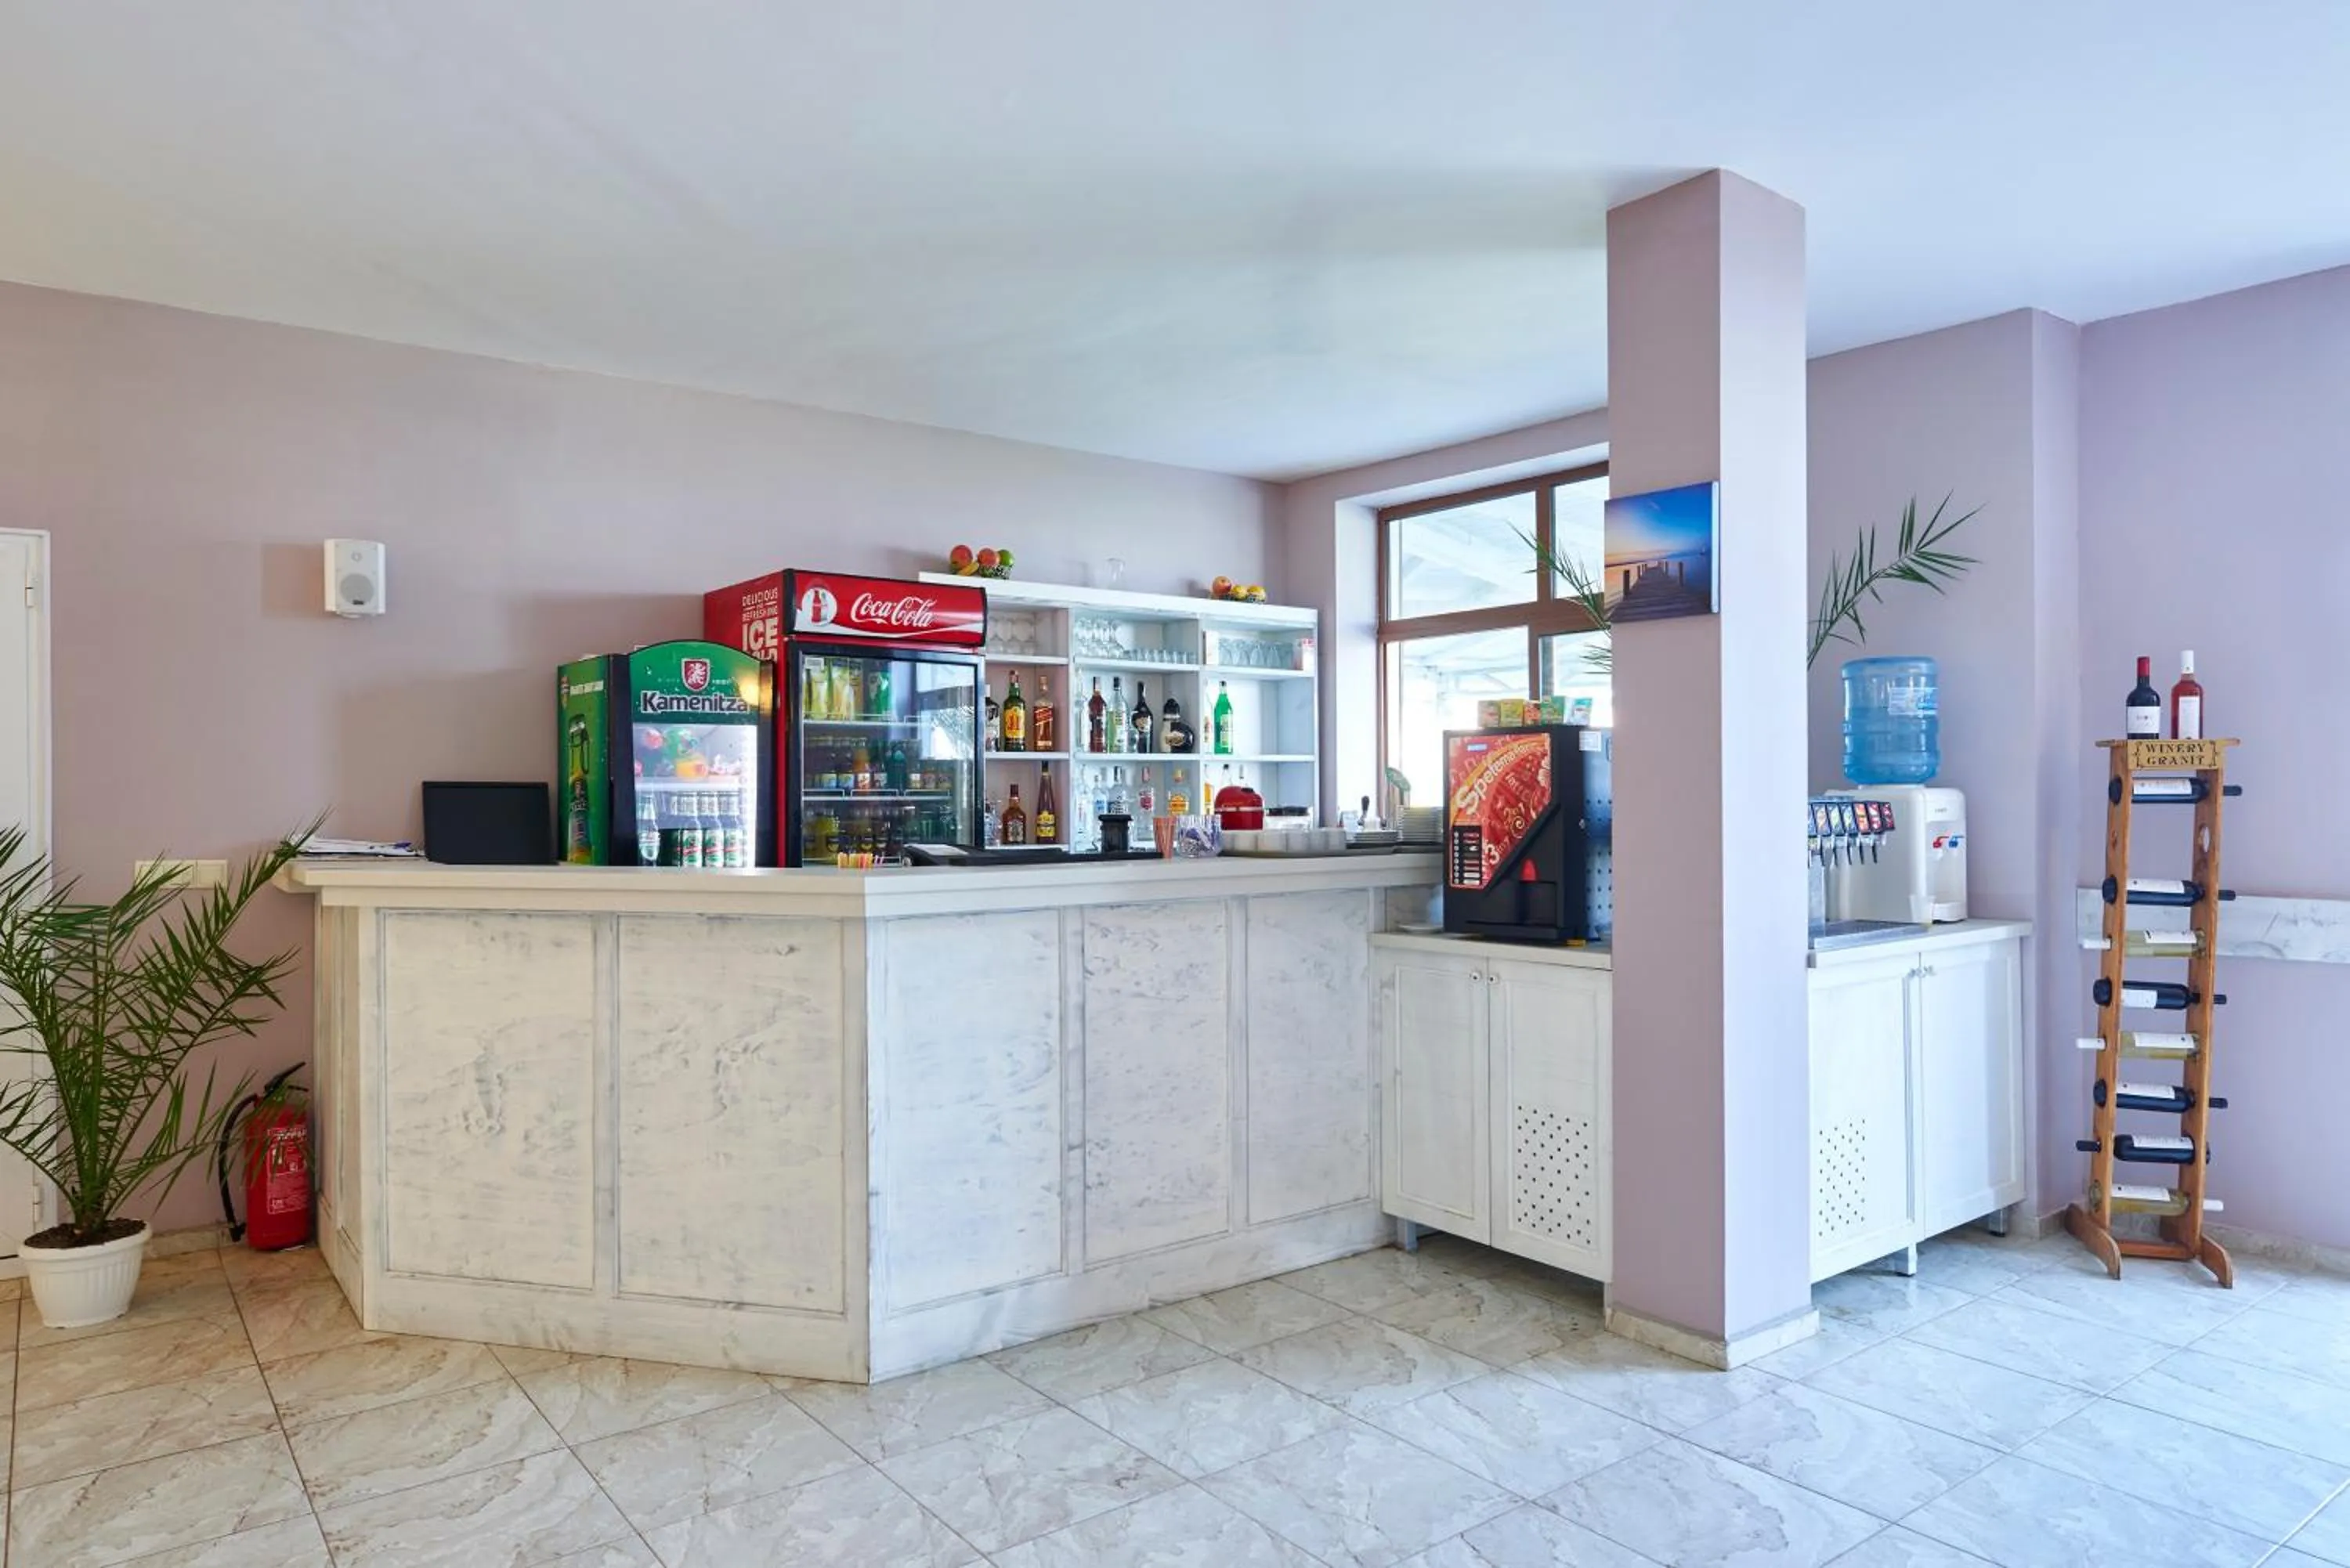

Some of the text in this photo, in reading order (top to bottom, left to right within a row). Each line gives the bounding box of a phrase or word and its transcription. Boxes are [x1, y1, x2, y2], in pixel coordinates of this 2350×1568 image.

[851, 593, 936, 627] Coca-Cola
[742, 616, 778, 652] ICE
[641, 690, 749, 714] Kamenitza
[2146, 742, 2205, 753] WINERY
[2146, 756, 2205, 765] GRANIT
